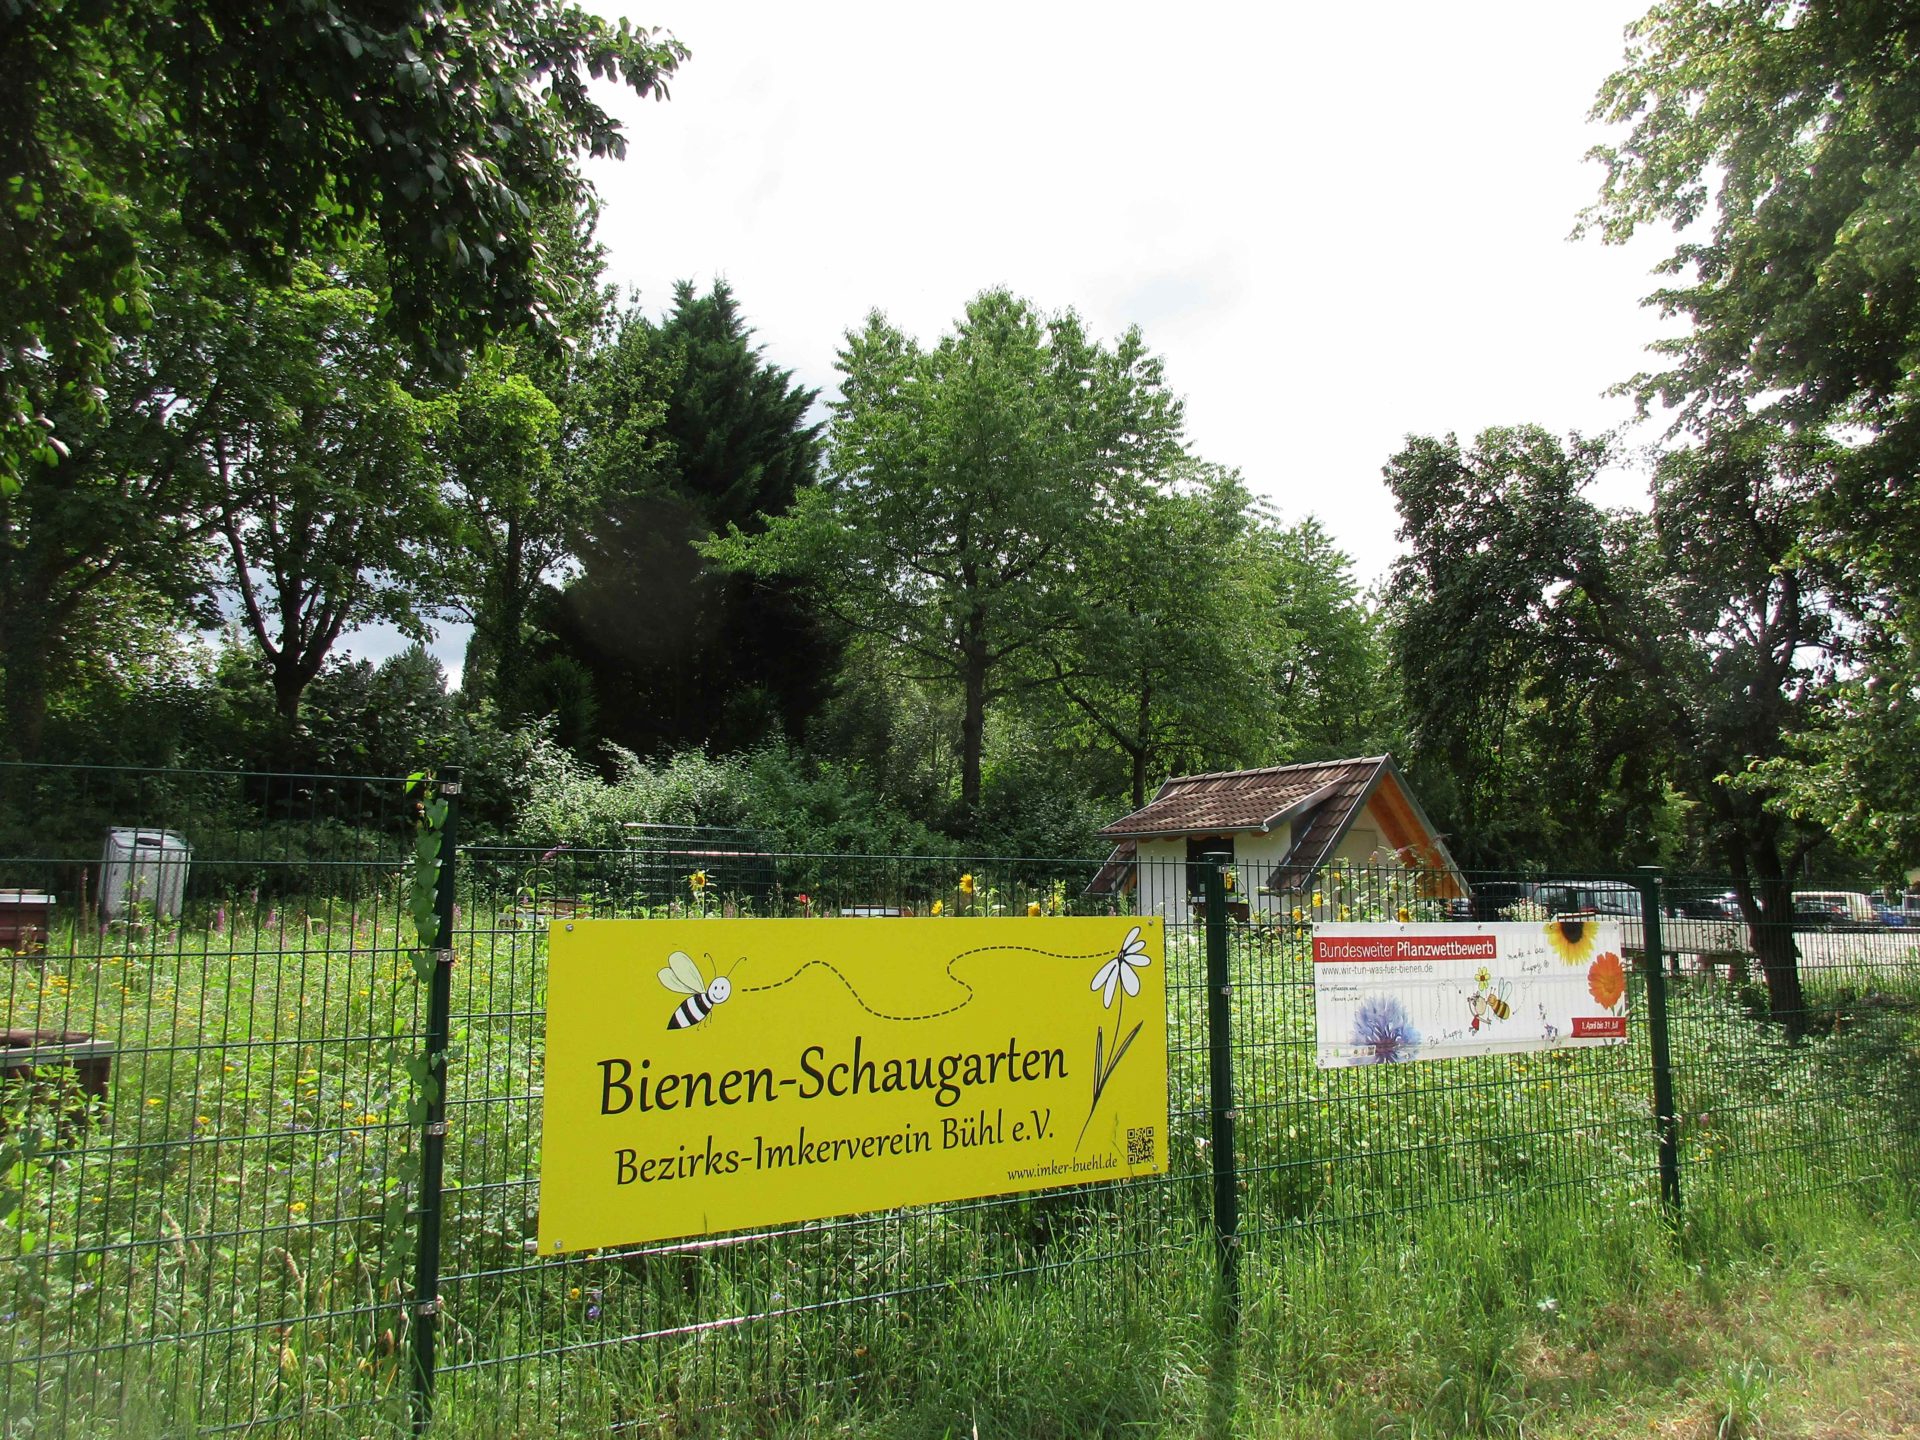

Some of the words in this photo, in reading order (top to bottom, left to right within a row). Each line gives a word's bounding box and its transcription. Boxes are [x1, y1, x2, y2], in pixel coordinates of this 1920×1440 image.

[1319, 941, 1394, 958] Bundesweiter
[1396, 940, 1494, 957] Pflanzwettbewerb
[1321, 963, 1433, 975] www.wir-tun-was-fuer-bienen.de
[597, 1036, 1069, 1116] Bienen-Schaugarten
[614, 1122, 932, 1186] Bezirks-Imkerverein
[940, 1108, 1004, 1150] Bühl
[1012, 1108, 1054, 1142] e.V.
[1007, 1152, 1118, 1181] www.imker-buehl.de
